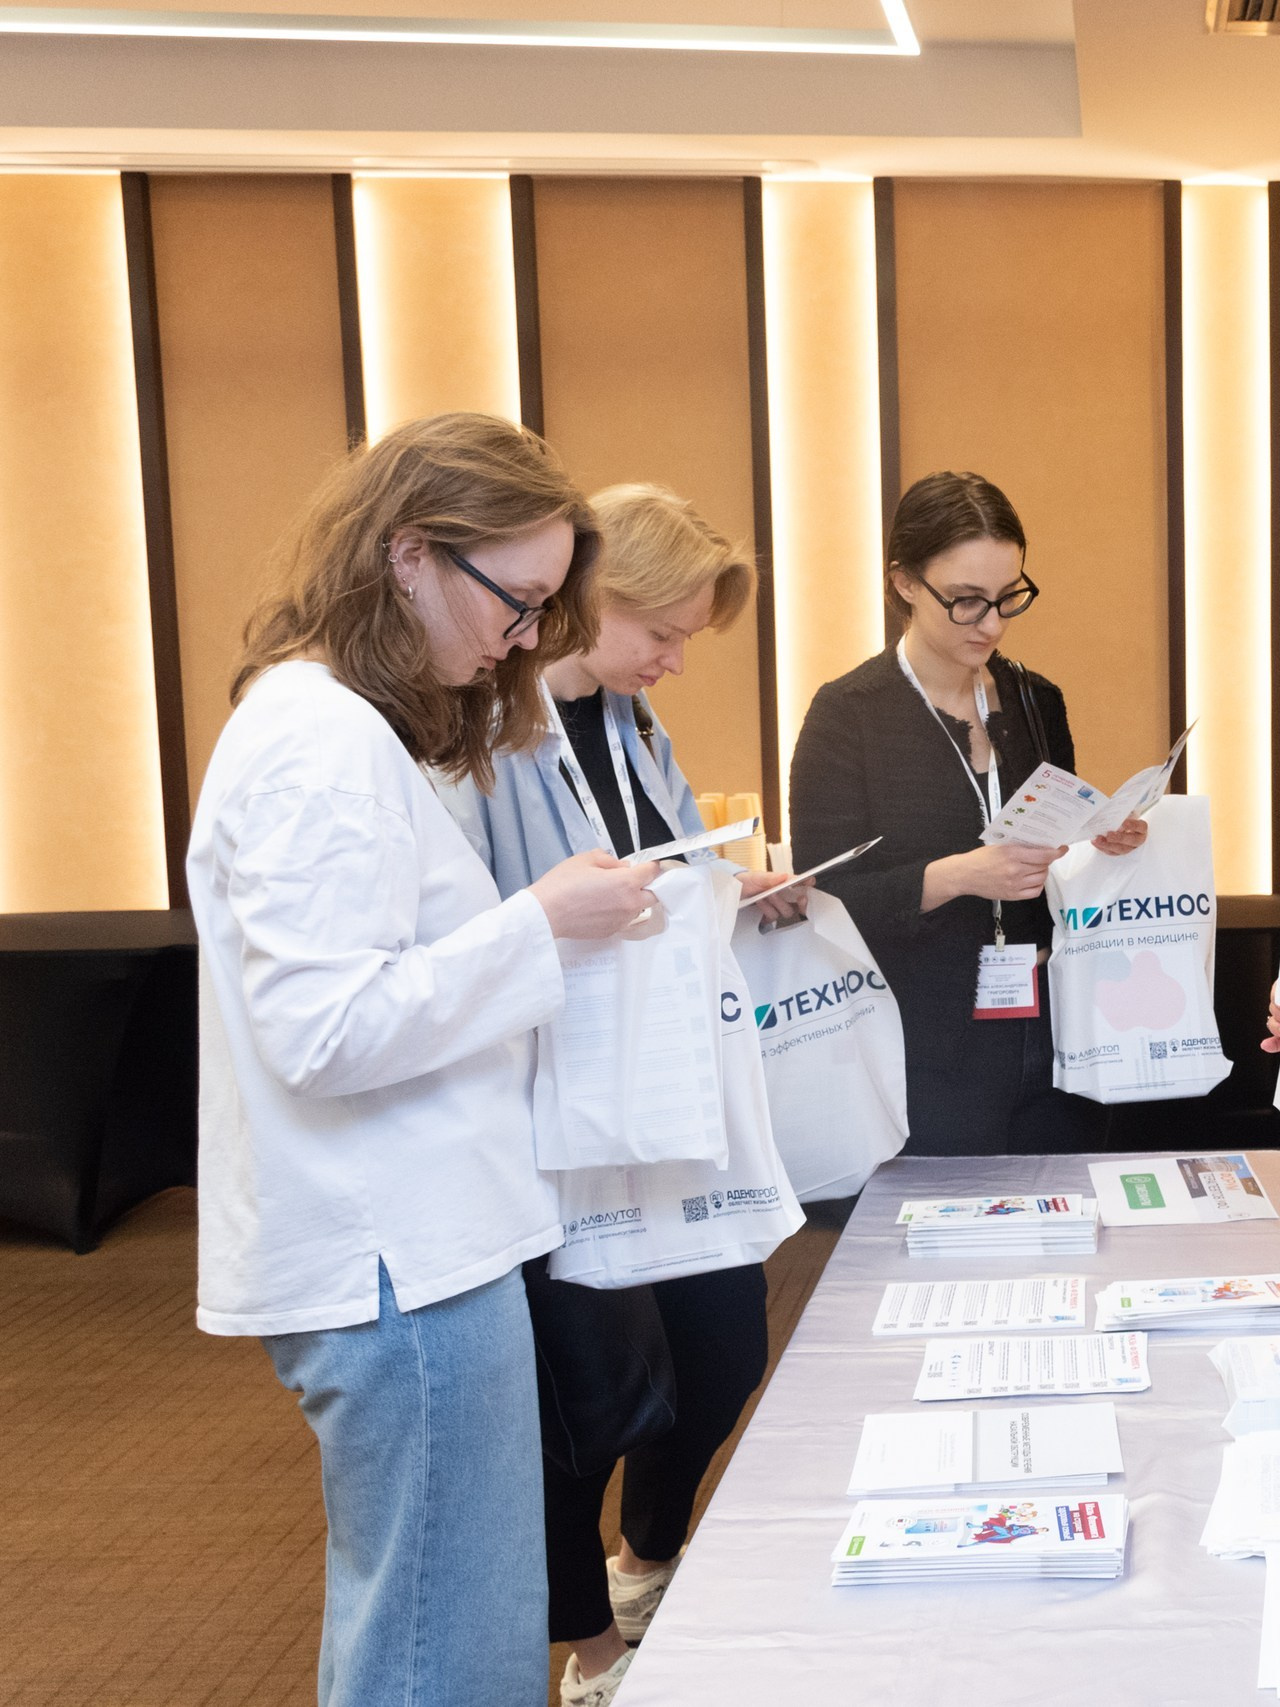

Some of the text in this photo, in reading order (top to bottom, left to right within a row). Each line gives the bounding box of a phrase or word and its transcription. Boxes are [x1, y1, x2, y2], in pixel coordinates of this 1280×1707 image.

[1064, 930, 1199, 956] Инновации в медицине
[769, 1022, 844, 1057] эффективных
[1181, 1036, 1221, 1048] АДЕНОПРО
[580, 1207, 642, 1227] АЛФЛУТОП
